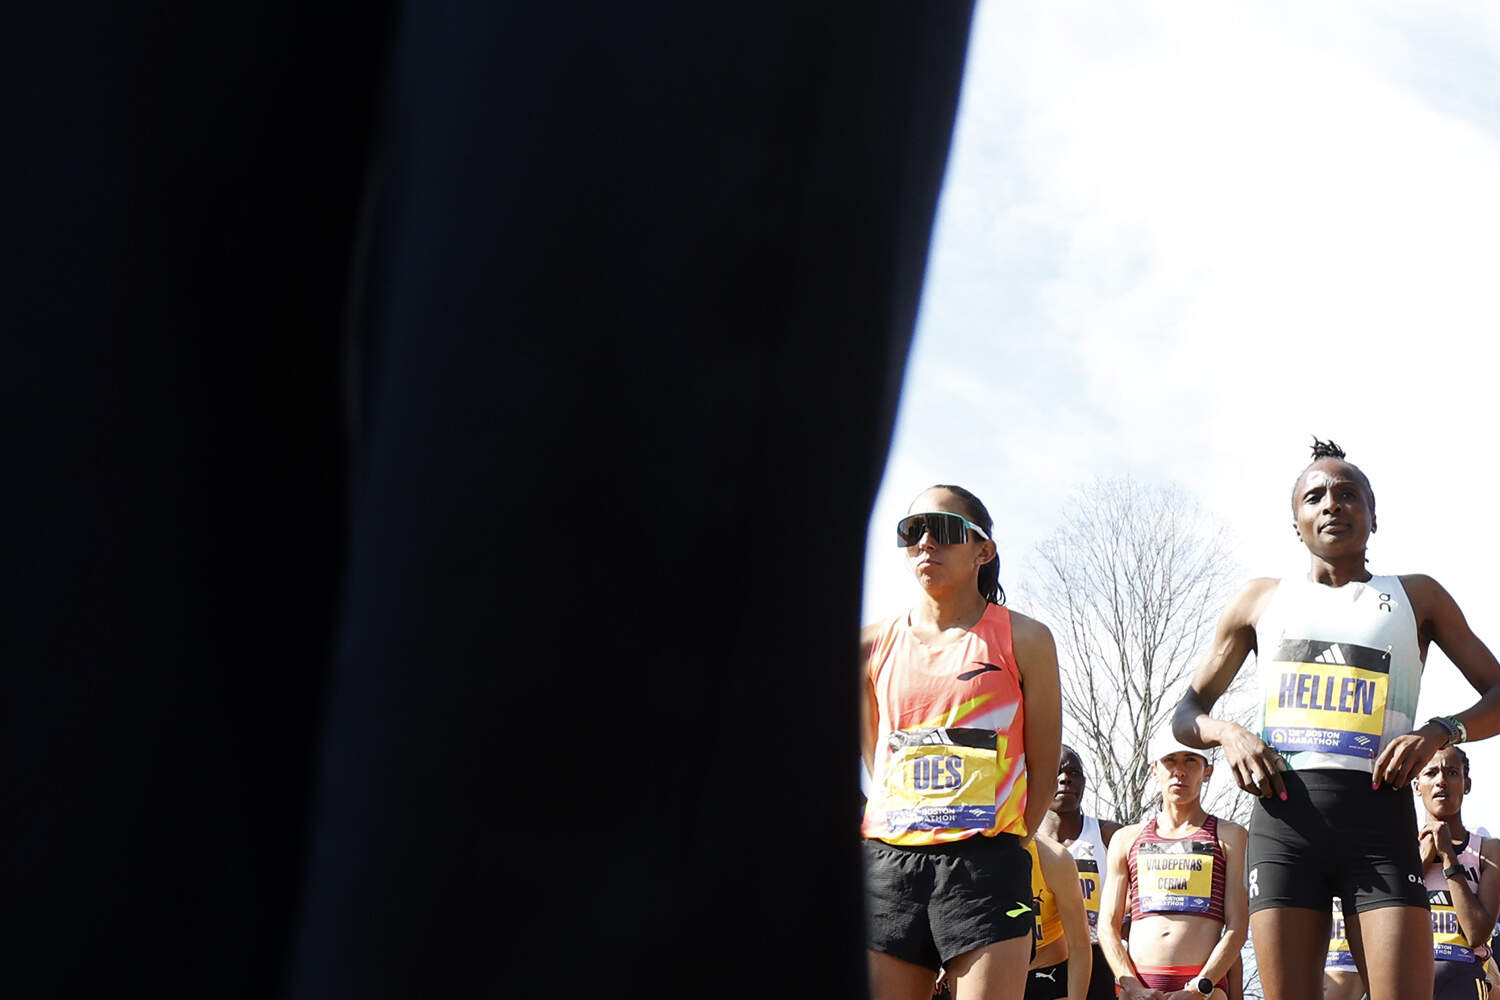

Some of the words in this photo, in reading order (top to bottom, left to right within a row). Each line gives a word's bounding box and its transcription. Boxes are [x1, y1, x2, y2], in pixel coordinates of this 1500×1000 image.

[1278, 672, 1376, 716] HELLEN
[1288, 735, 1340, 746] MARATHON
[1305, 729, 1340, 739] BOSTON
[914, 755, 962, 790] DES
